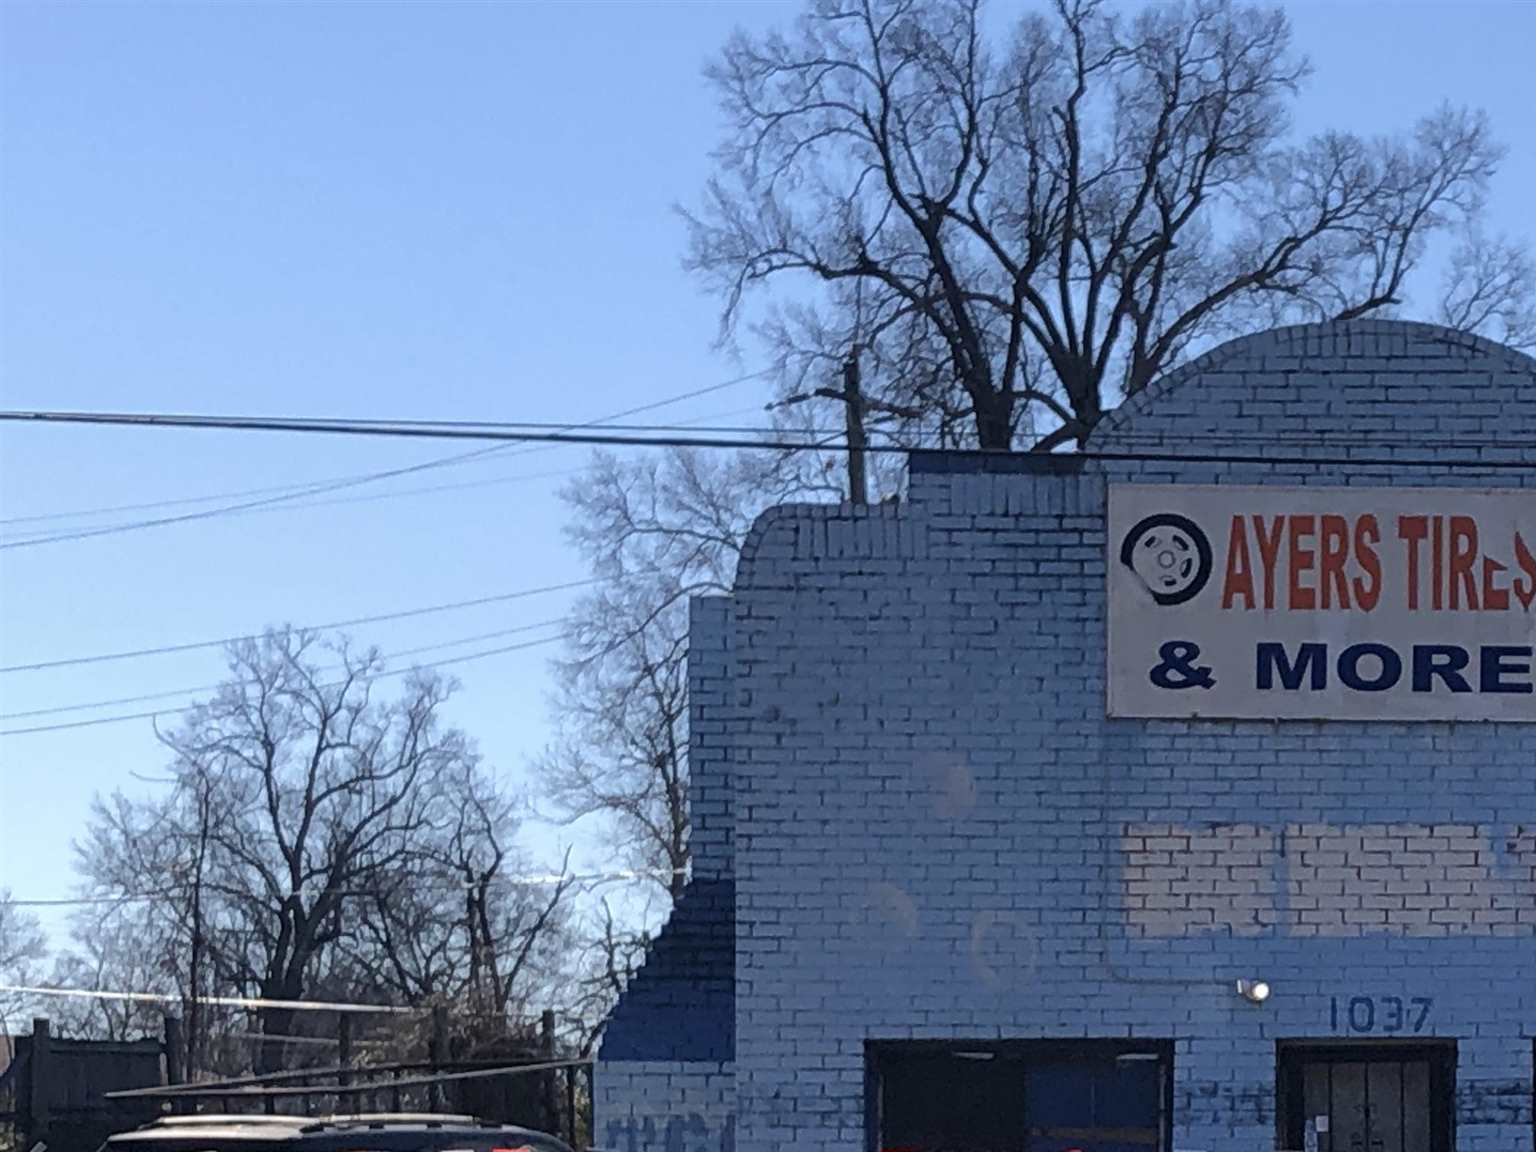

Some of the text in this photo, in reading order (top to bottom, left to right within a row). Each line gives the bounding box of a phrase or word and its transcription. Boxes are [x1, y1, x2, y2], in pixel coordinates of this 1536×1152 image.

[1220, 513, 1382, 613] AYERS
[1148, 640, 1534, 694] & MORE
[1330, 996, 1434, 1033] 1037
